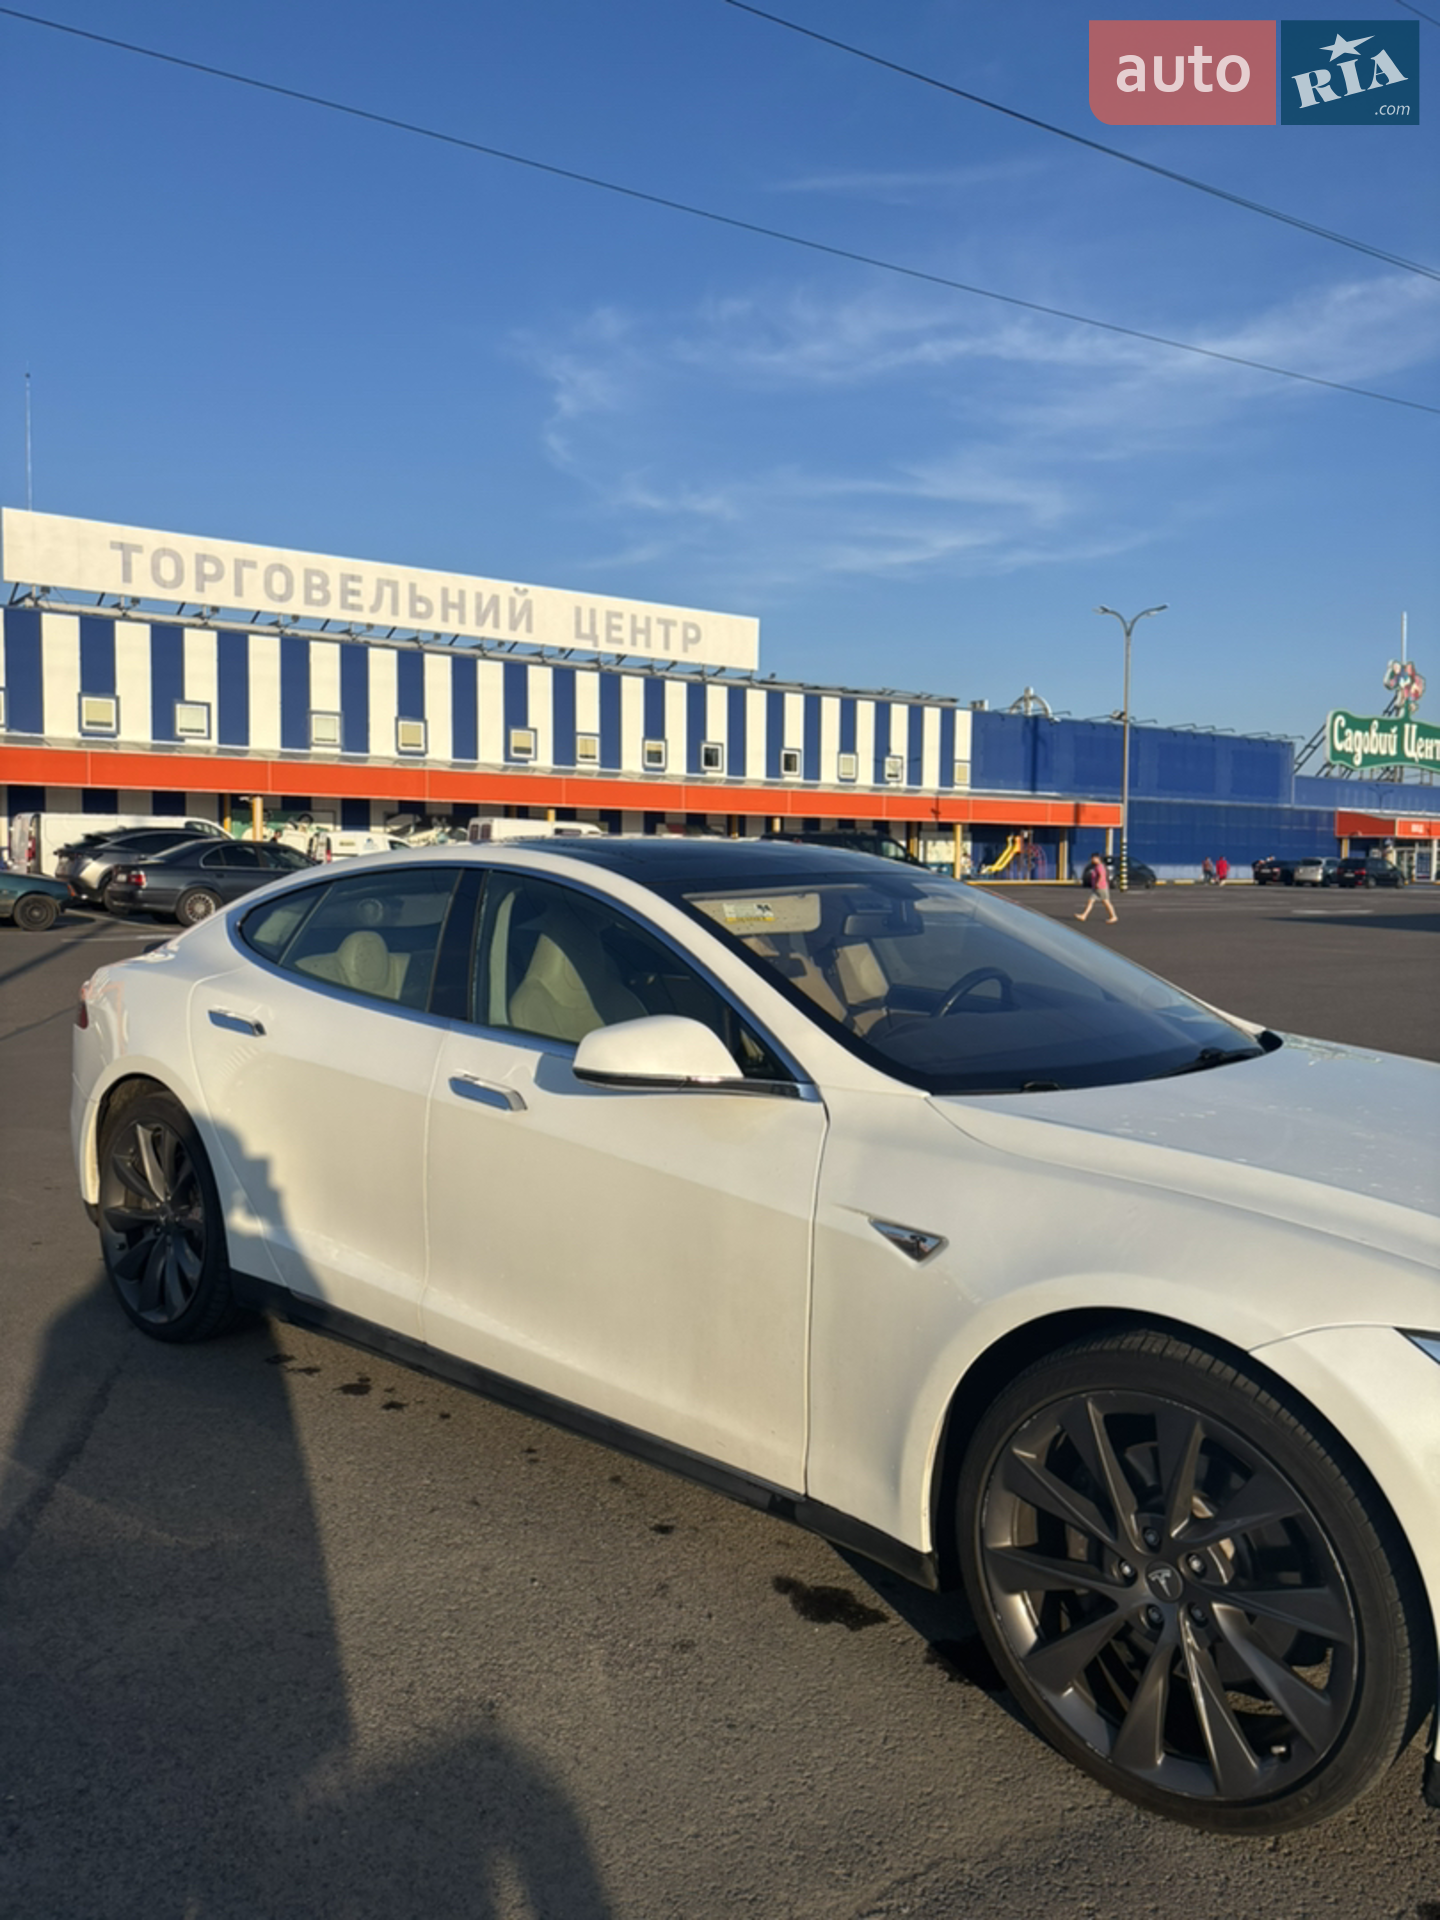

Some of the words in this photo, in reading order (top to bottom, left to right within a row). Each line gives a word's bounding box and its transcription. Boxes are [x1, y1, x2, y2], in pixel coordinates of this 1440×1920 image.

[110, 540, 533, 634] ТОРГОВЕЛЬНИЙ
[574, 605, 703, 653] ЦЕНТР
[1334, 715, 1397, 765] Садовий
